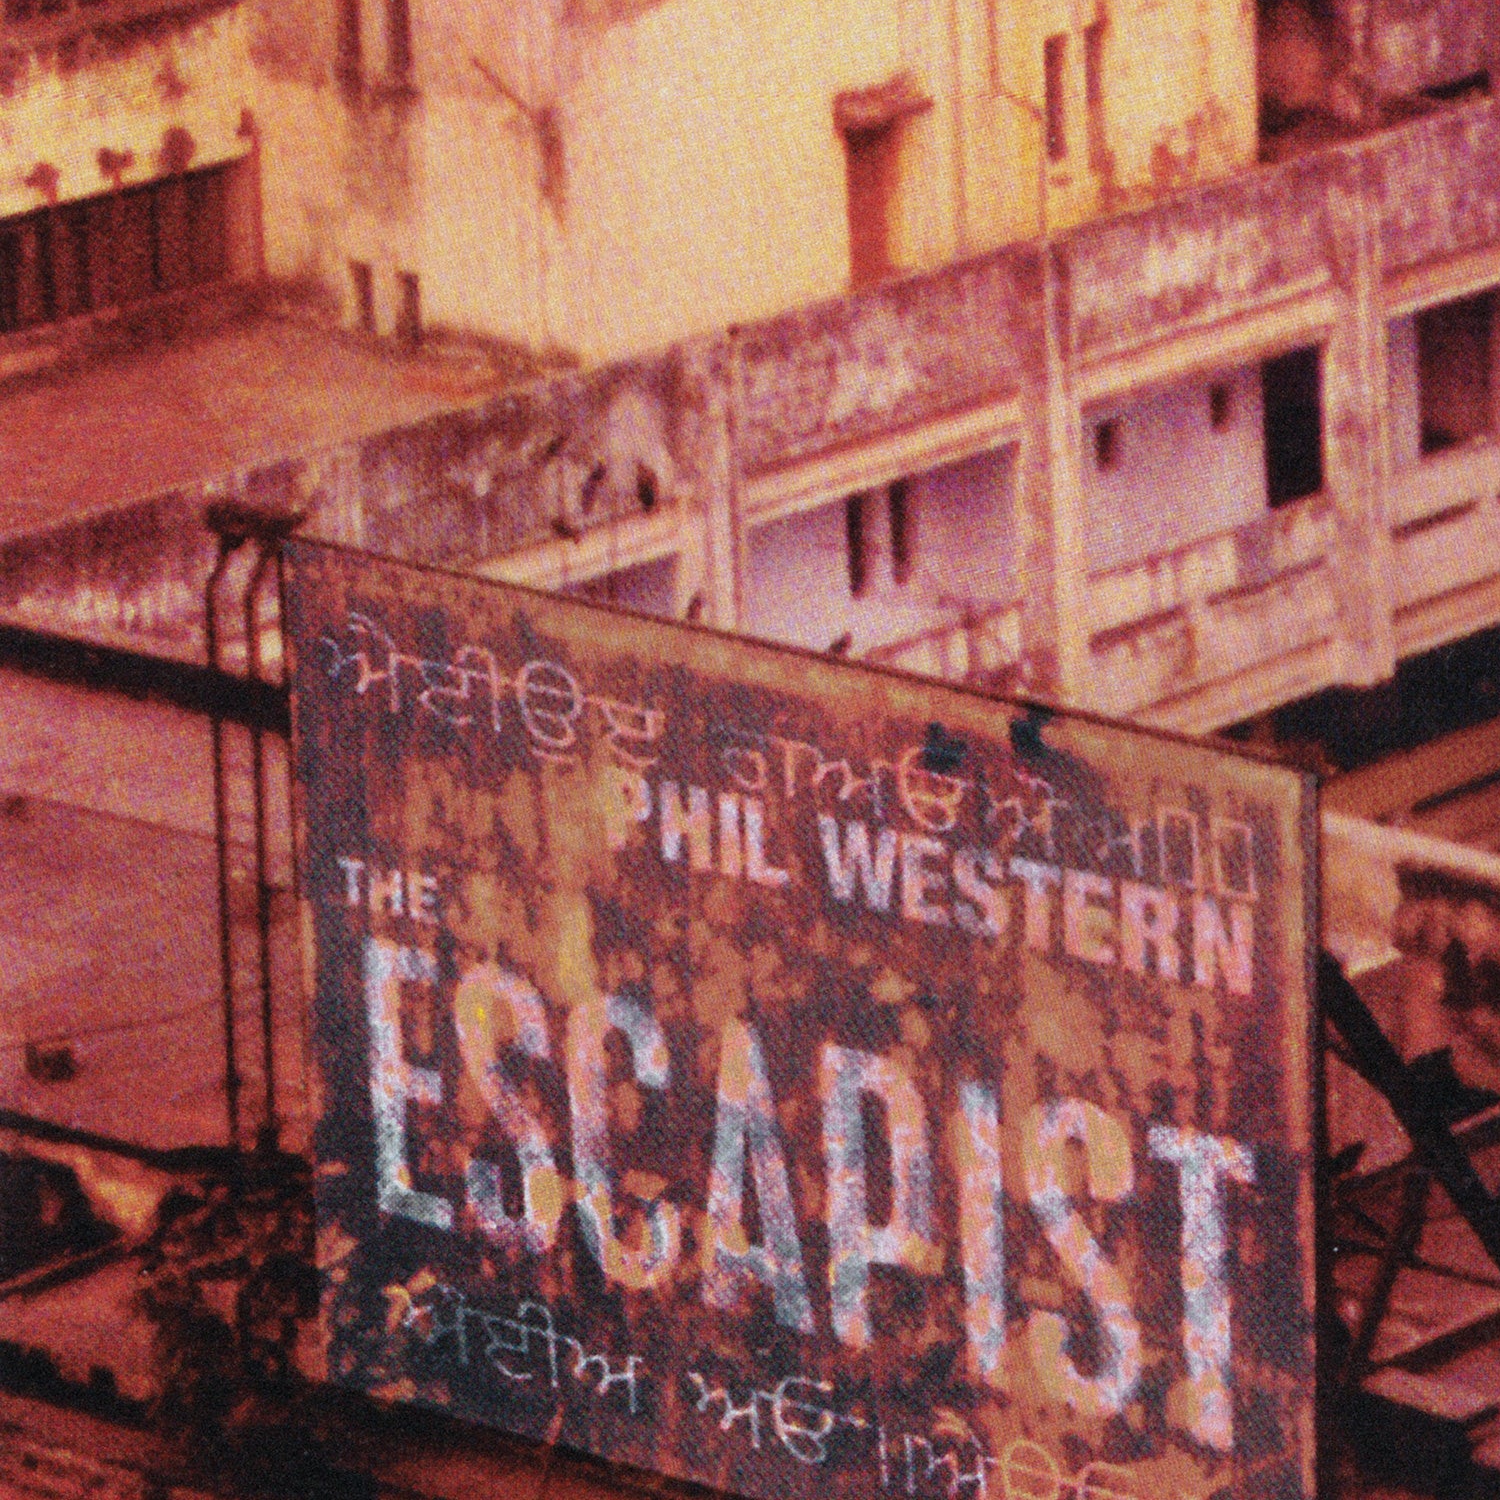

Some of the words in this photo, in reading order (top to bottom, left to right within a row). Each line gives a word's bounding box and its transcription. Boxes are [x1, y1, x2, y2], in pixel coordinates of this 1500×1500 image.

[338, 856, 439, 920] THE
[600, 763, 790, 887] PHIL
[817, 811, 1256, 997] WESTERN
[365, 936, 1258, 1450] ESCAPIST
